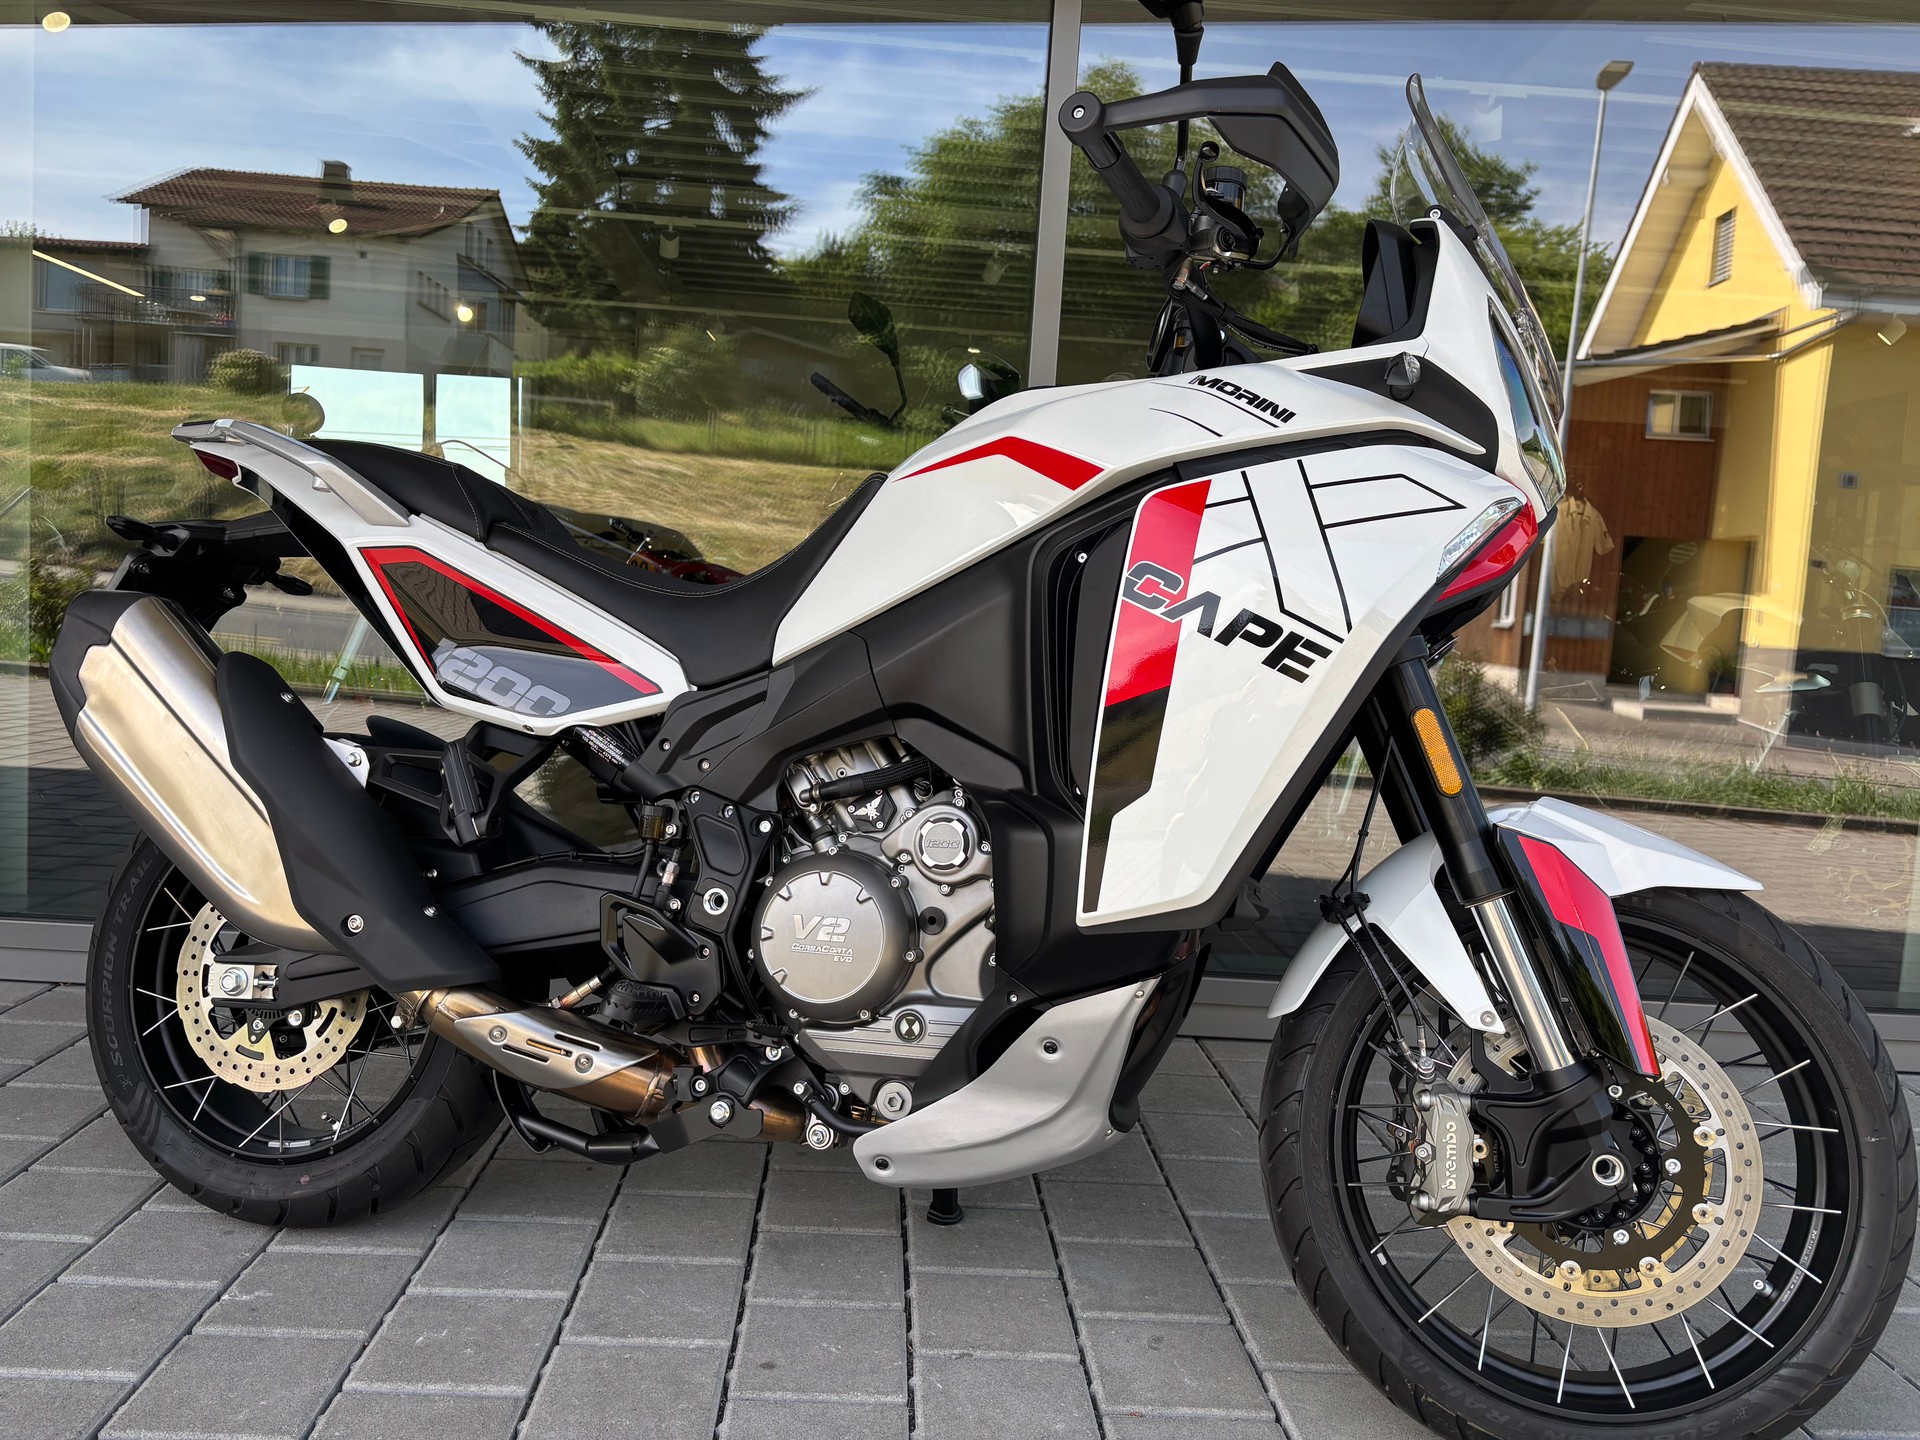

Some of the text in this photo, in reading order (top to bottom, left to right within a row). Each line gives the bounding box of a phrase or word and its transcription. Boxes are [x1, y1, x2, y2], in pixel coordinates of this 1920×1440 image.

[1189, 375, 1297, 424] MORINI
[1122, 561, 1333, 684] CAPE
[432, 638, 571, 716] 1200
[102, 858, 153, 1067] SCORPION TRAIL
[793, 914, 852, 943] V2
[1442, 1121, 1457, 1190] brembo
[1427, 1371, 1529, 1434] TRAIL
